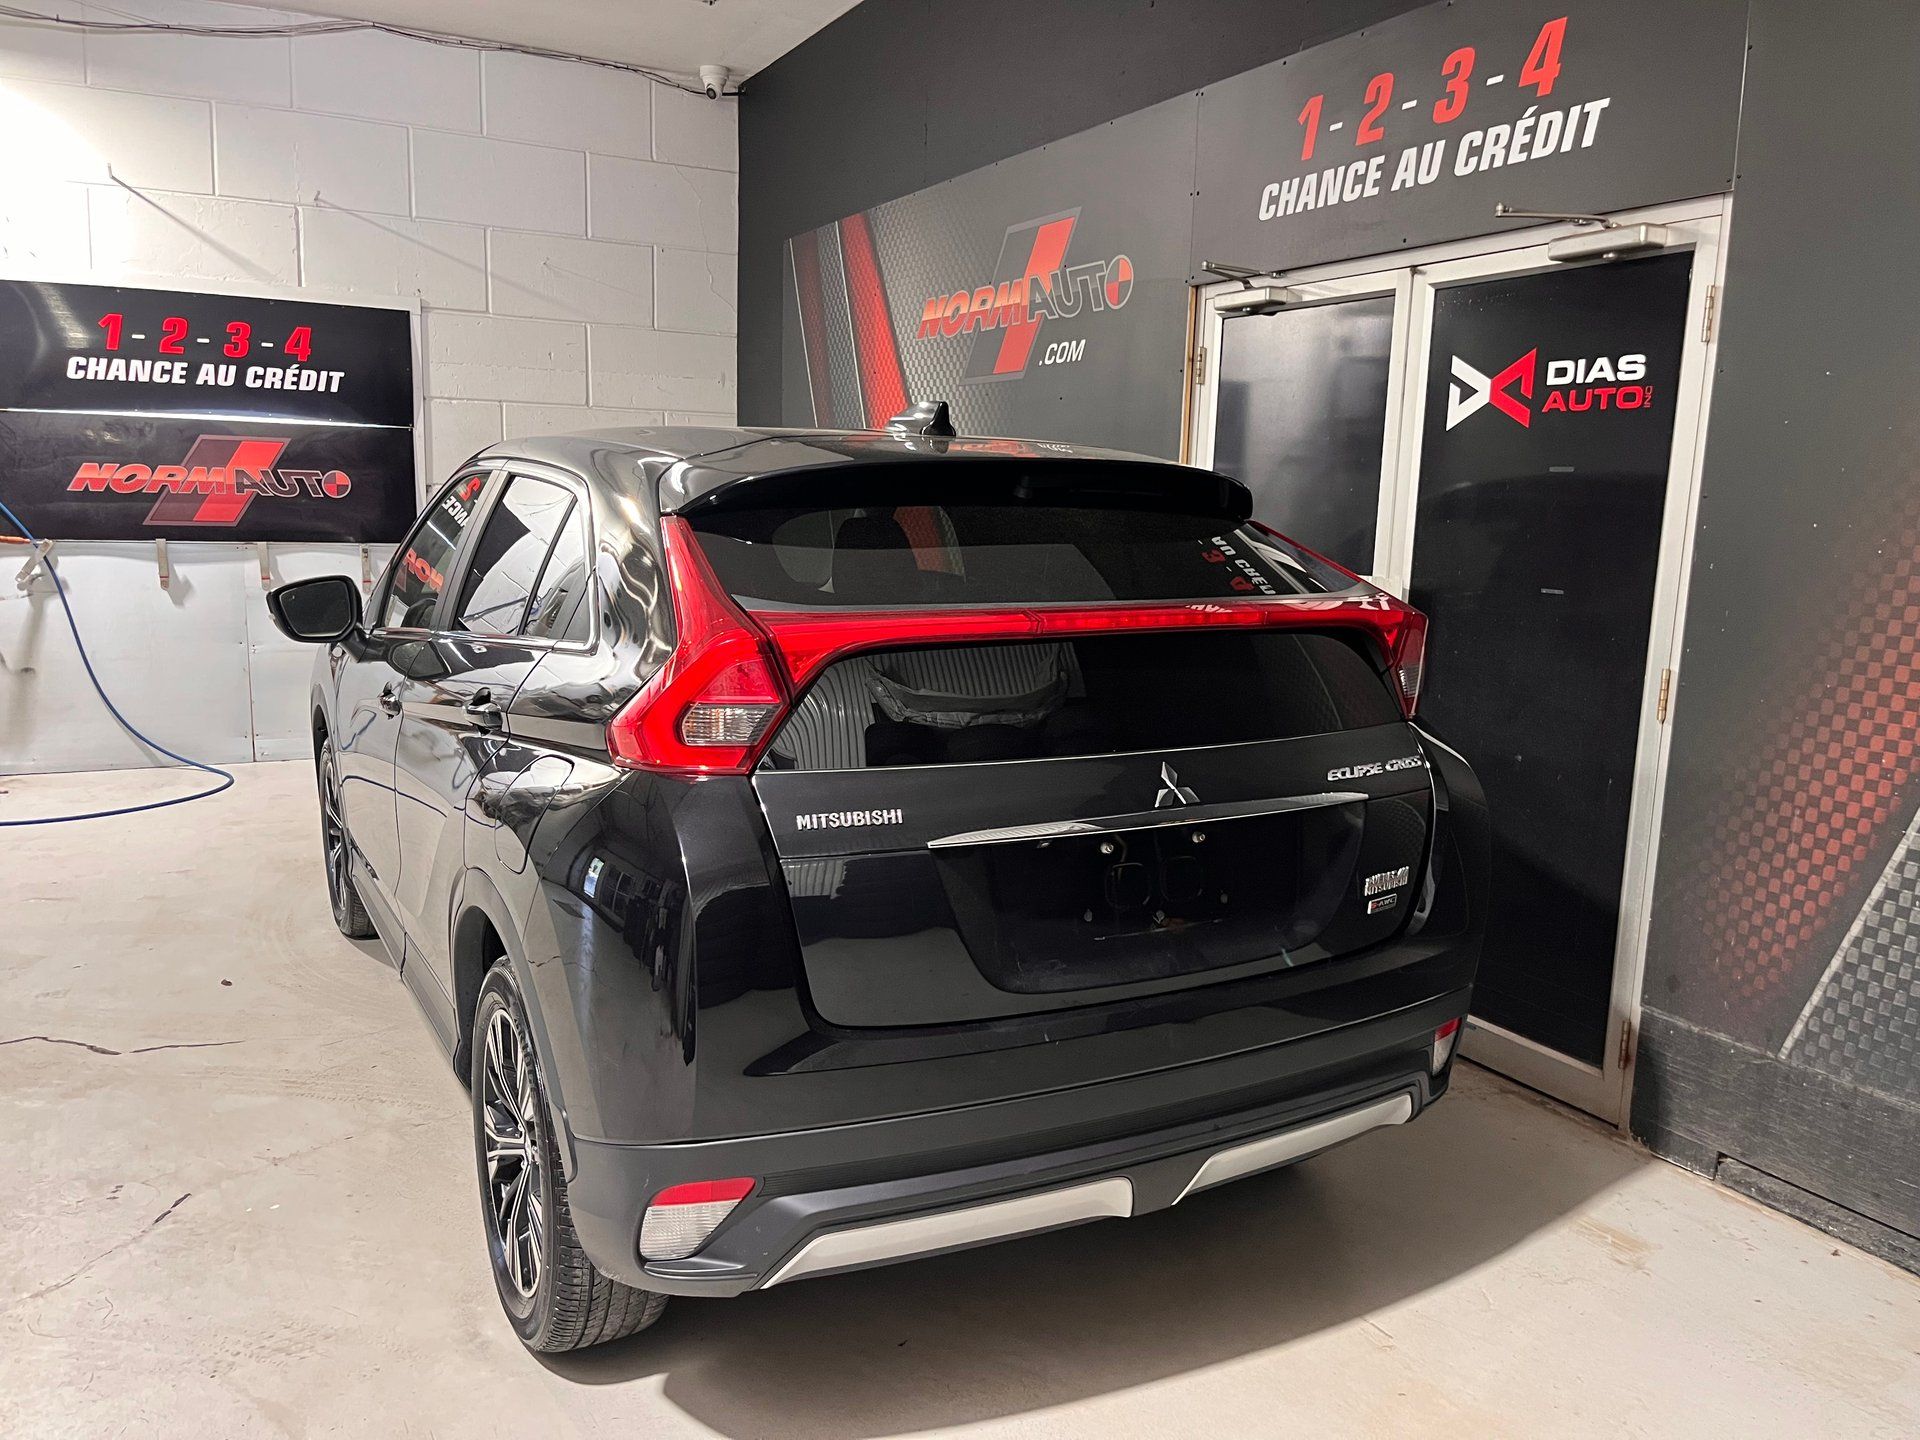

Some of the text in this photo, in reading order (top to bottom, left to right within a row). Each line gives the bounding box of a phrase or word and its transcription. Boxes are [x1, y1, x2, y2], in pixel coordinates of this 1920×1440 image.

[1258, 97, 1611, 222] CHANCE AU CRÉDIT
[916, 254, 1134, 341] NORMAUTO
[1038, 339, 1086, 366] .COM
[66, 356, 345, 393] CHANCE AU CRÉDIT
[1546, 353, 1647, 386] DIAS
[1541, 385, 1644, 413] AUTO
[66, 462, 352, 499] NORMAUTO
[1327, 762, 1383, 781] ECLIPSE
[796, 808, 903, 831] MITSUBISHI
